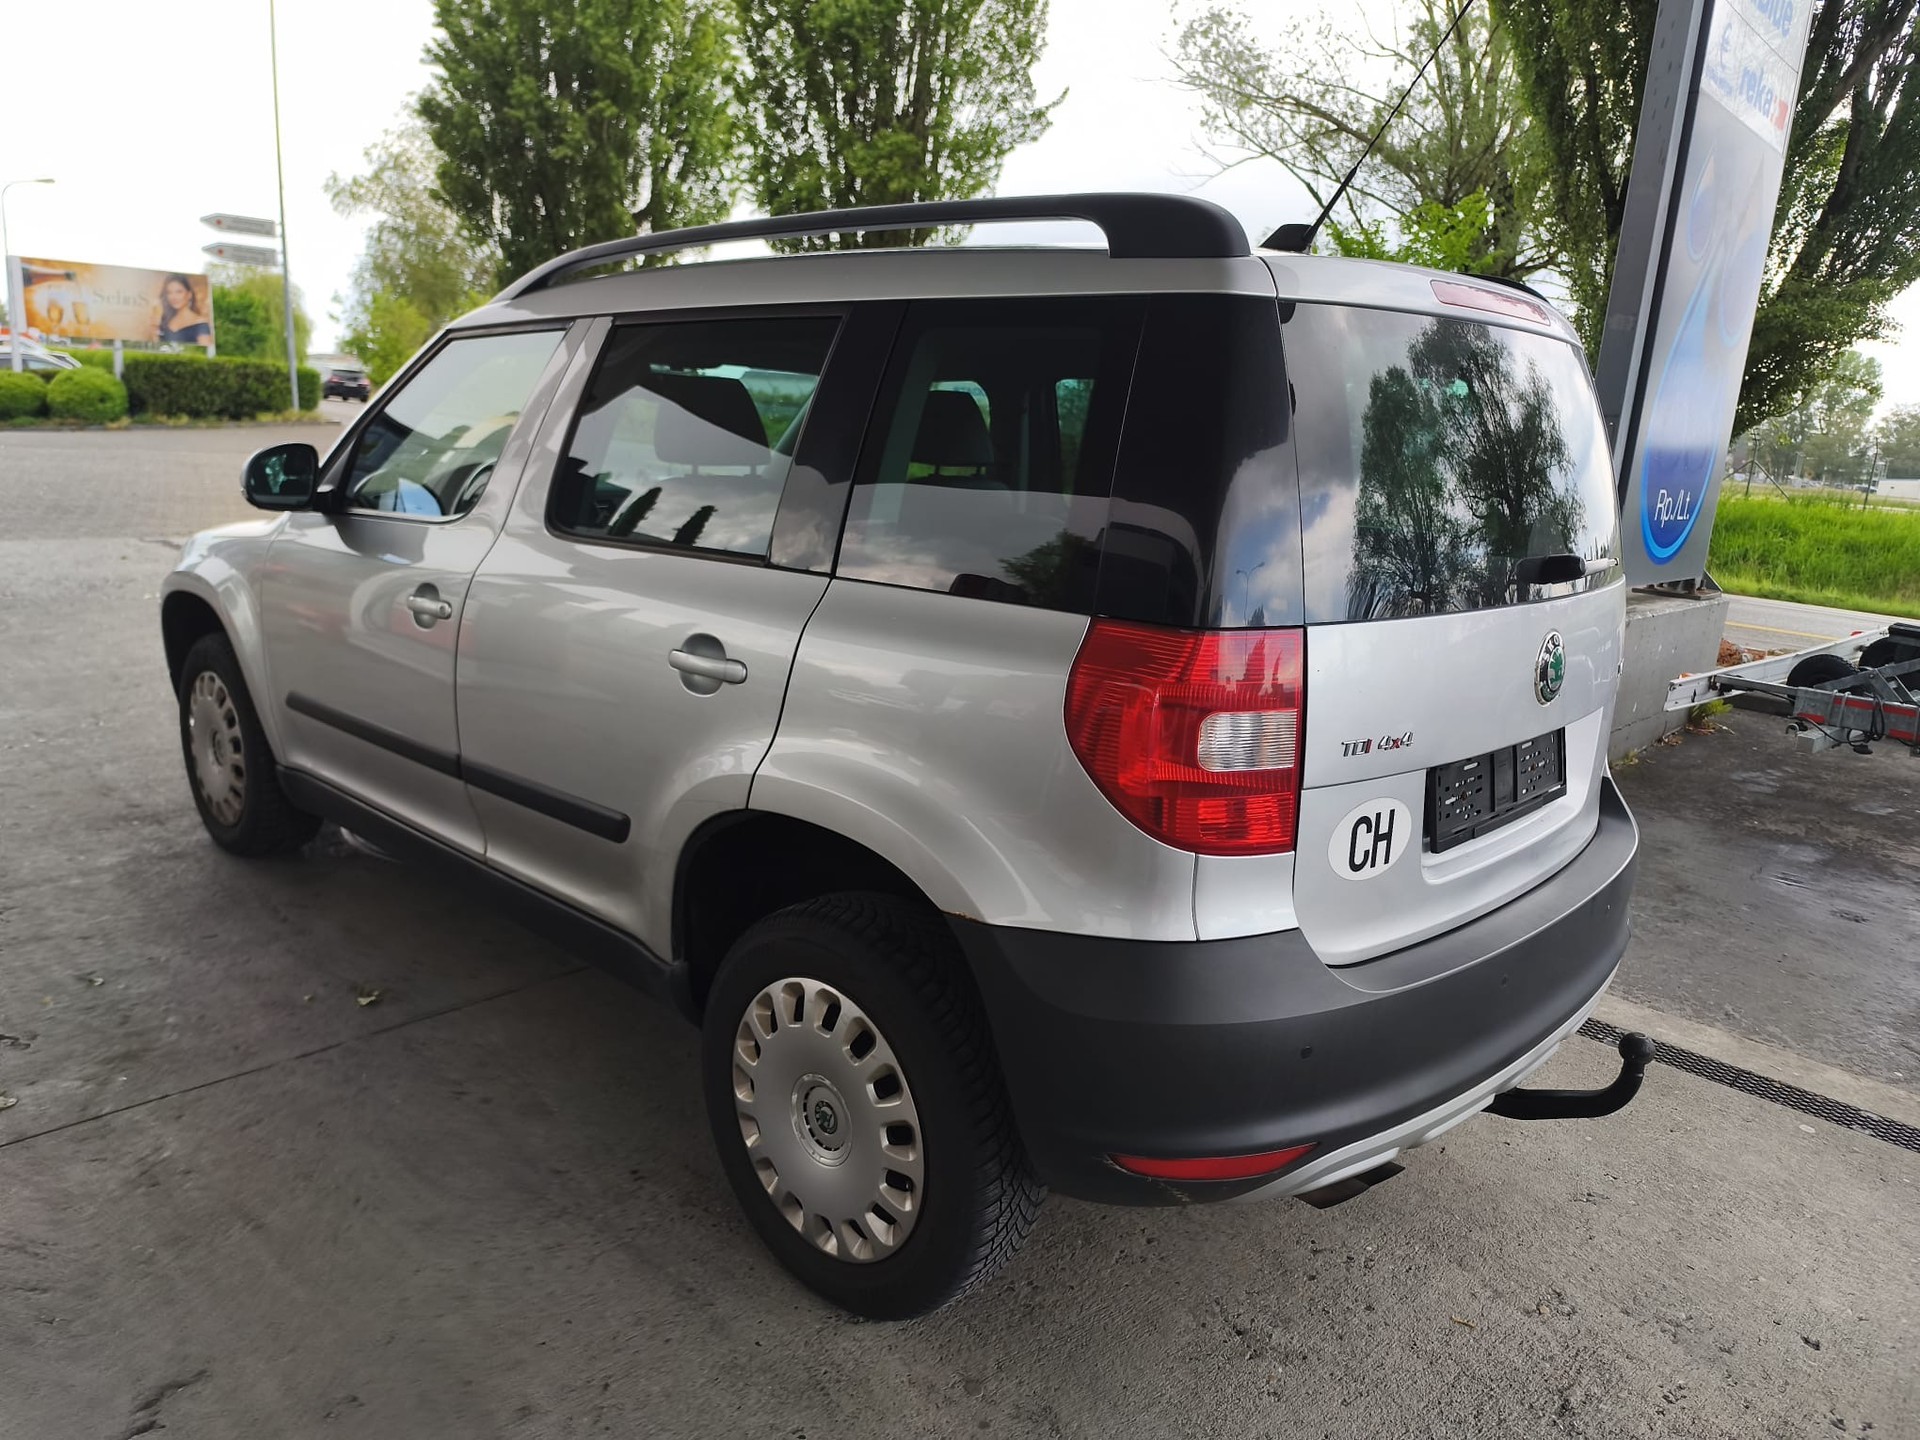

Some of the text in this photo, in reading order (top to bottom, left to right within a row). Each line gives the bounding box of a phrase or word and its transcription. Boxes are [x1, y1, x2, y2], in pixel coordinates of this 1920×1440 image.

[1341, 731, 1414, 757] TDI 4x4
[1349, 808, 1396, 873] CH
